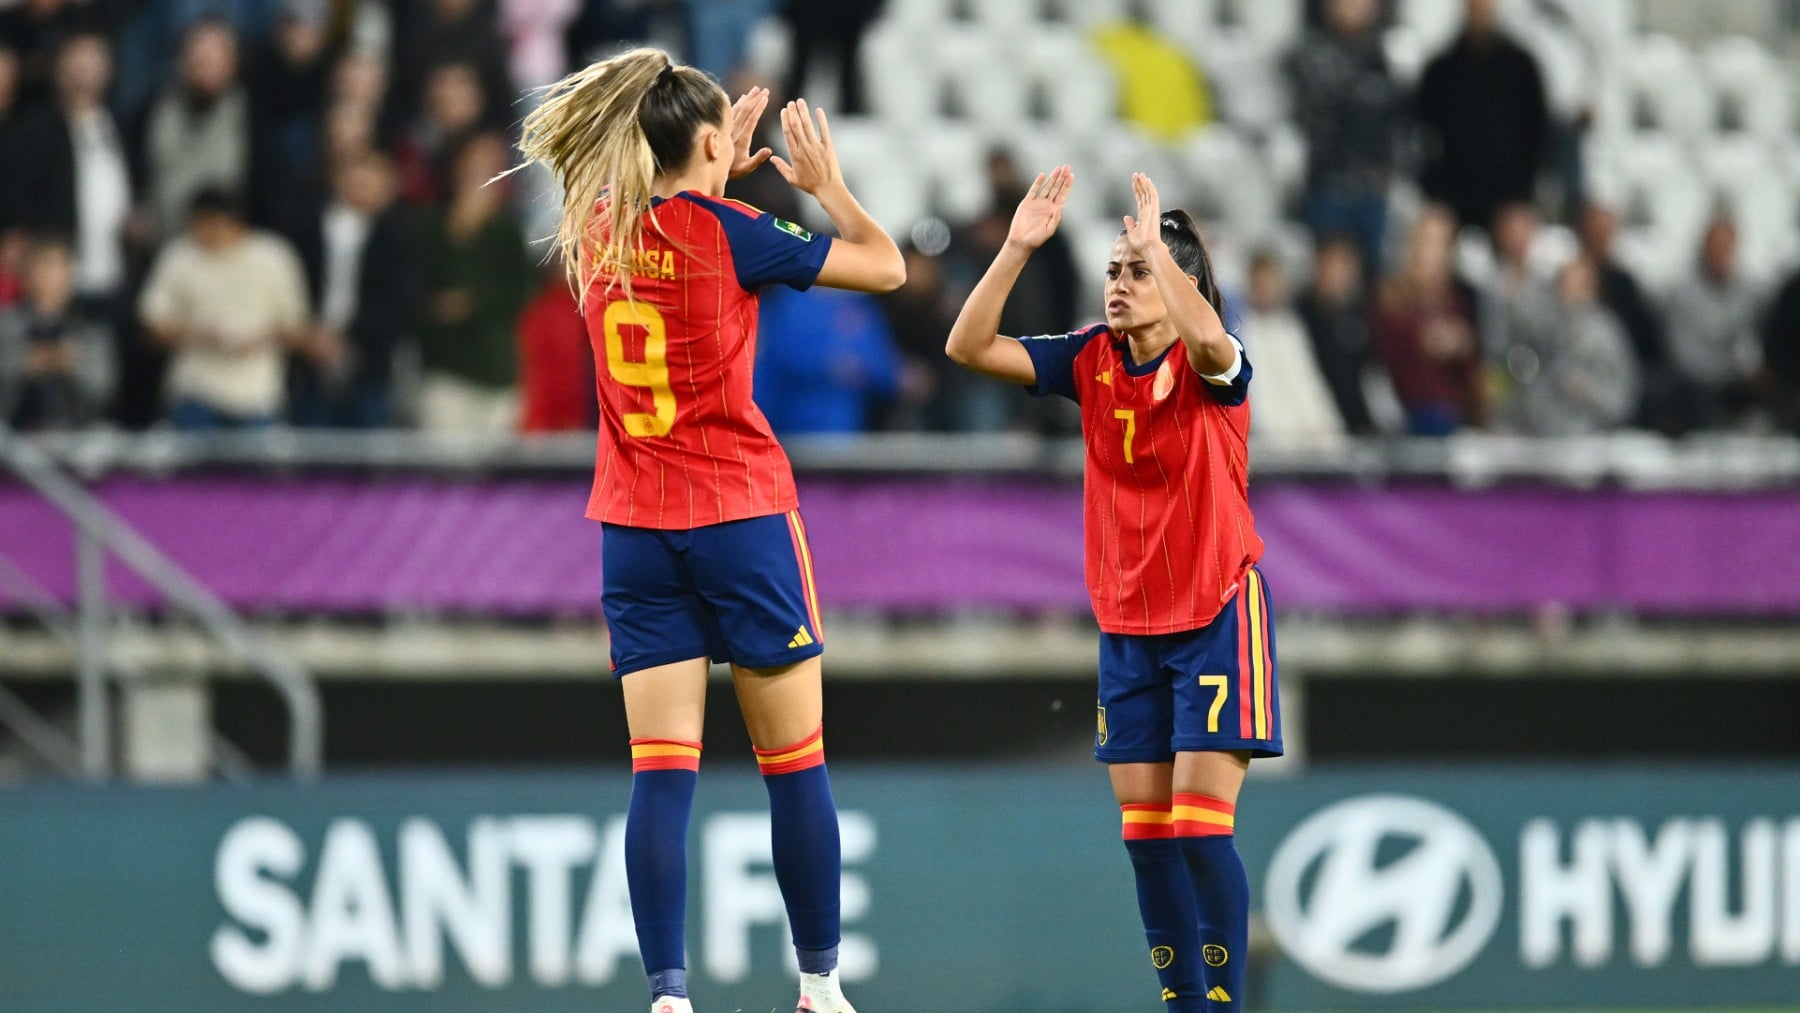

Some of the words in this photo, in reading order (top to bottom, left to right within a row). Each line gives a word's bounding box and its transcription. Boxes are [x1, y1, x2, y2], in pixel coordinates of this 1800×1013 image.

[604, 300, 677, 438] 9
[1114, 409, 1136, 464] 7
[1199, 675, 1228, 733] 7
[210, 815, 693, 994] SANTA
